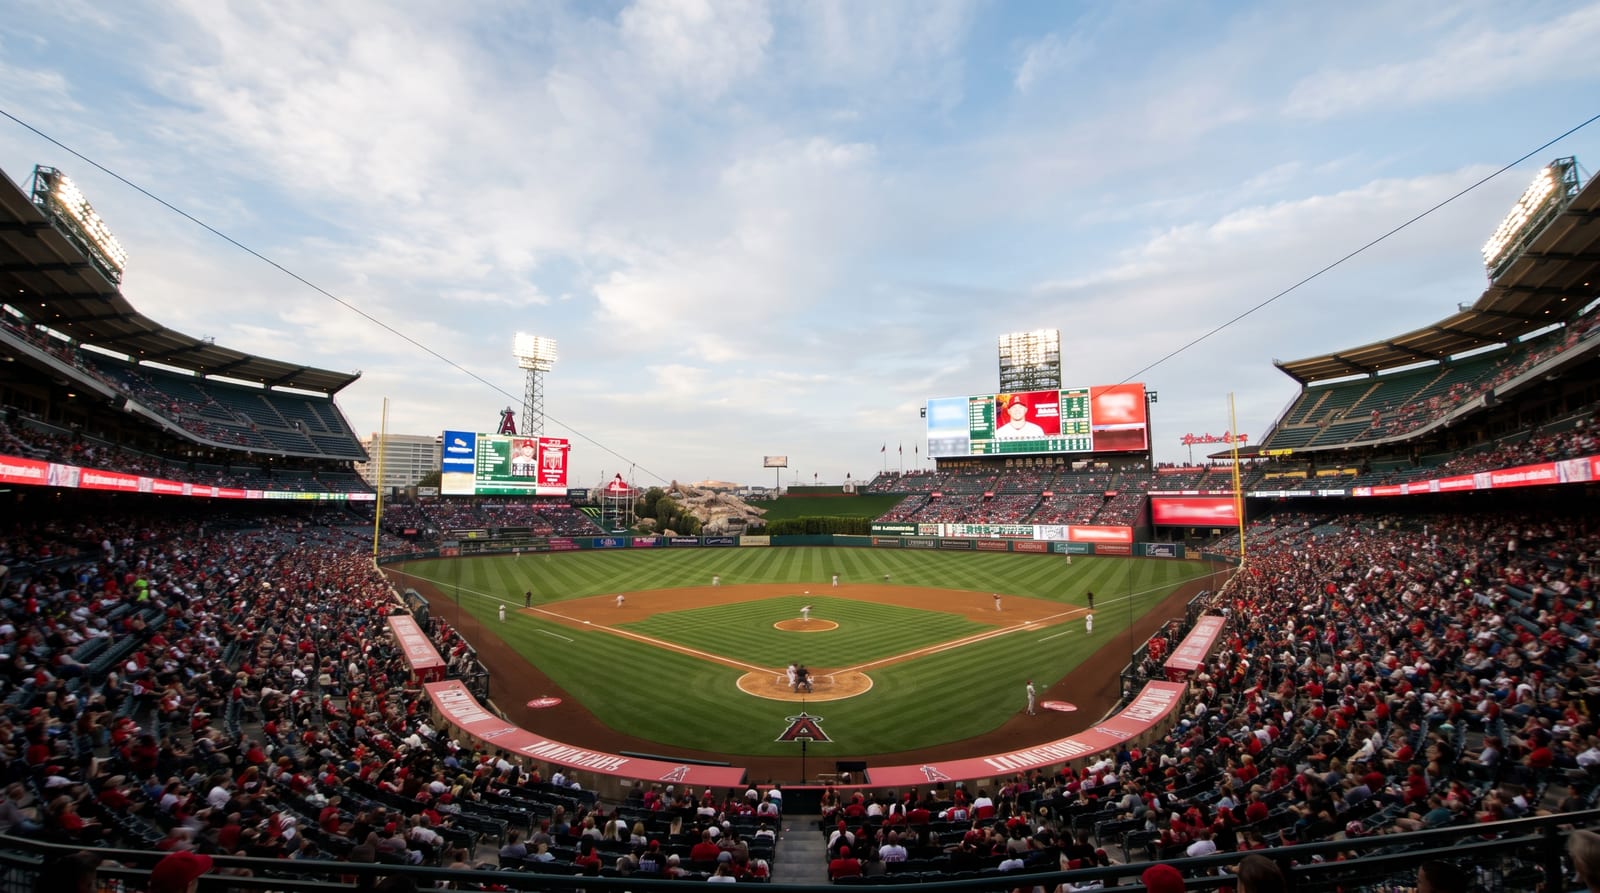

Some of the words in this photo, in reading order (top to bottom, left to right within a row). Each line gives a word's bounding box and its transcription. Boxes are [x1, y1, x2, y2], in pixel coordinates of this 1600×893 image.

[499, 406, 517, 435] A
[774, 712, 834, 742] A
[659, 765, 690, 782] A
[920, 765, 952, 782] A
